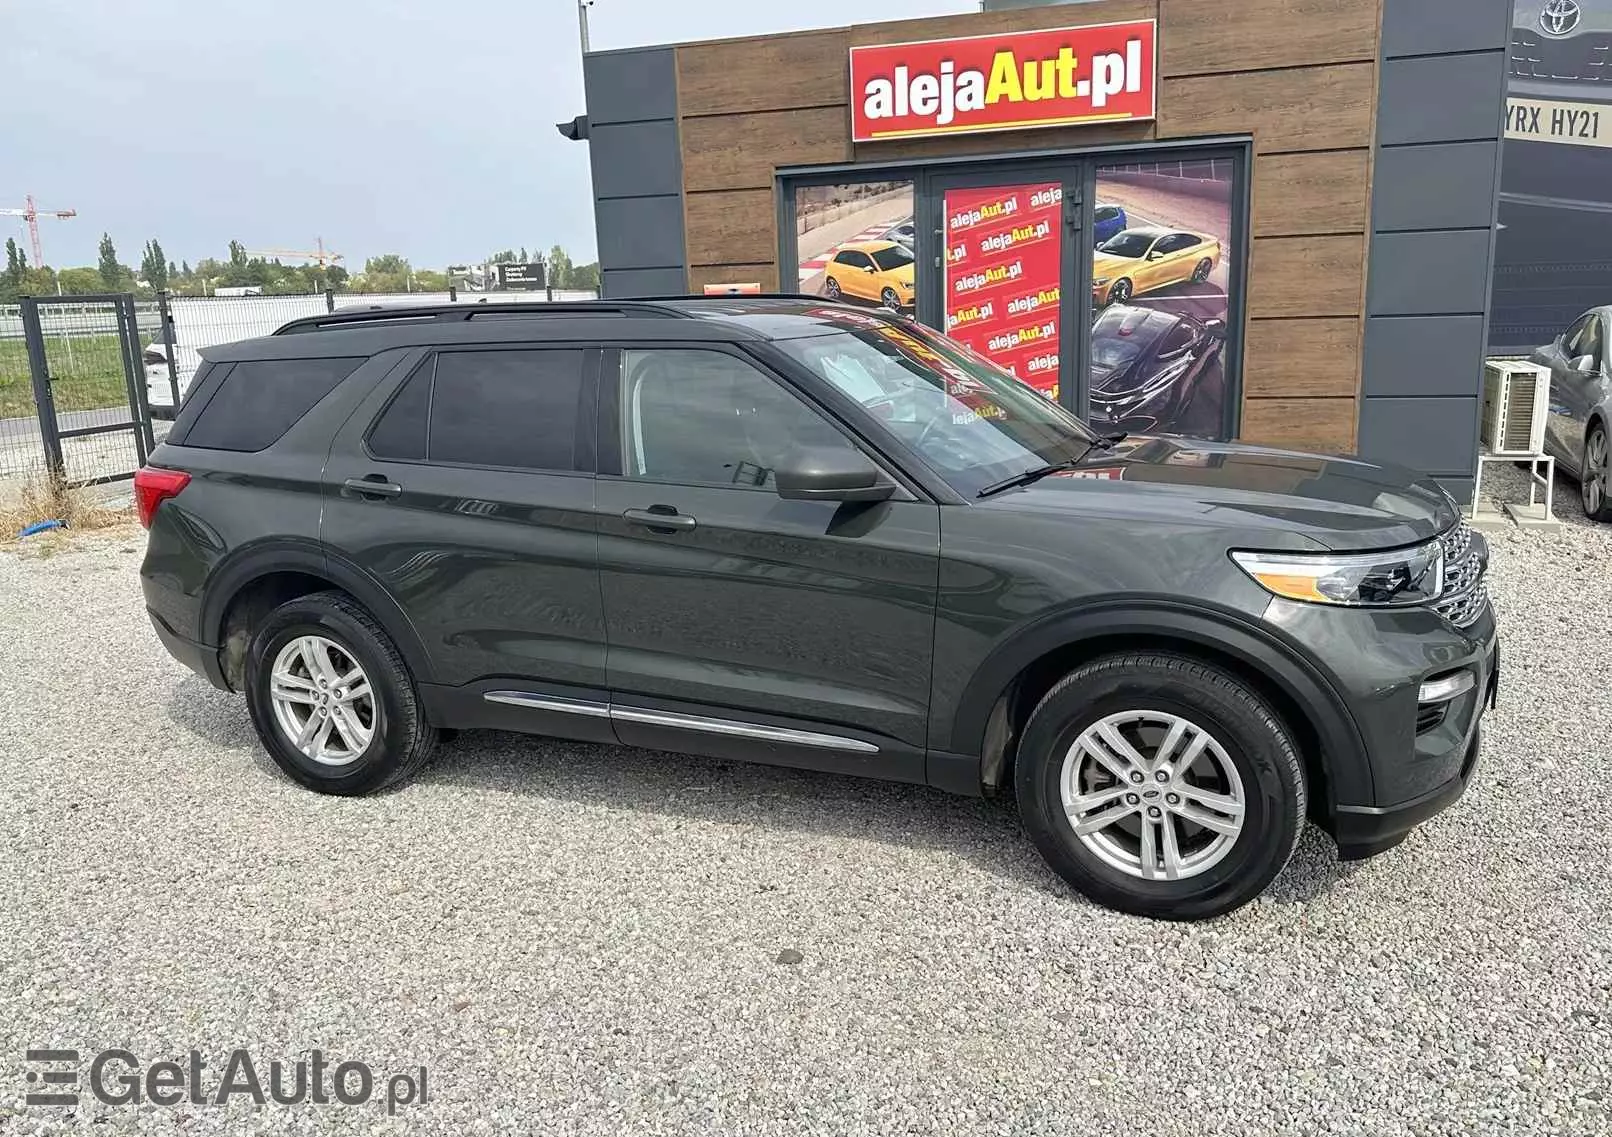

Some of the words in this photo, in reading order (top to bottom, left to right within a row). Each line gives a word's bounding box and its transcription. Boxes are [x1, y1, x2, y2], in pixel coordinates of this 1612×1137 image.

[863, 39, 1142, 125] alejaAut.pl
[1551, 108, 1599, 138] HY21
[1030, 187, 1062, 207] aleja
[950, 197, 1018, 229] alejaAut.pl
[981, 220, 1050, 252] alejaAut.pl
[955, 261, 1022, 291] alejaAut.pl
[988, 322, 1055, 350] alejaAut.pl
